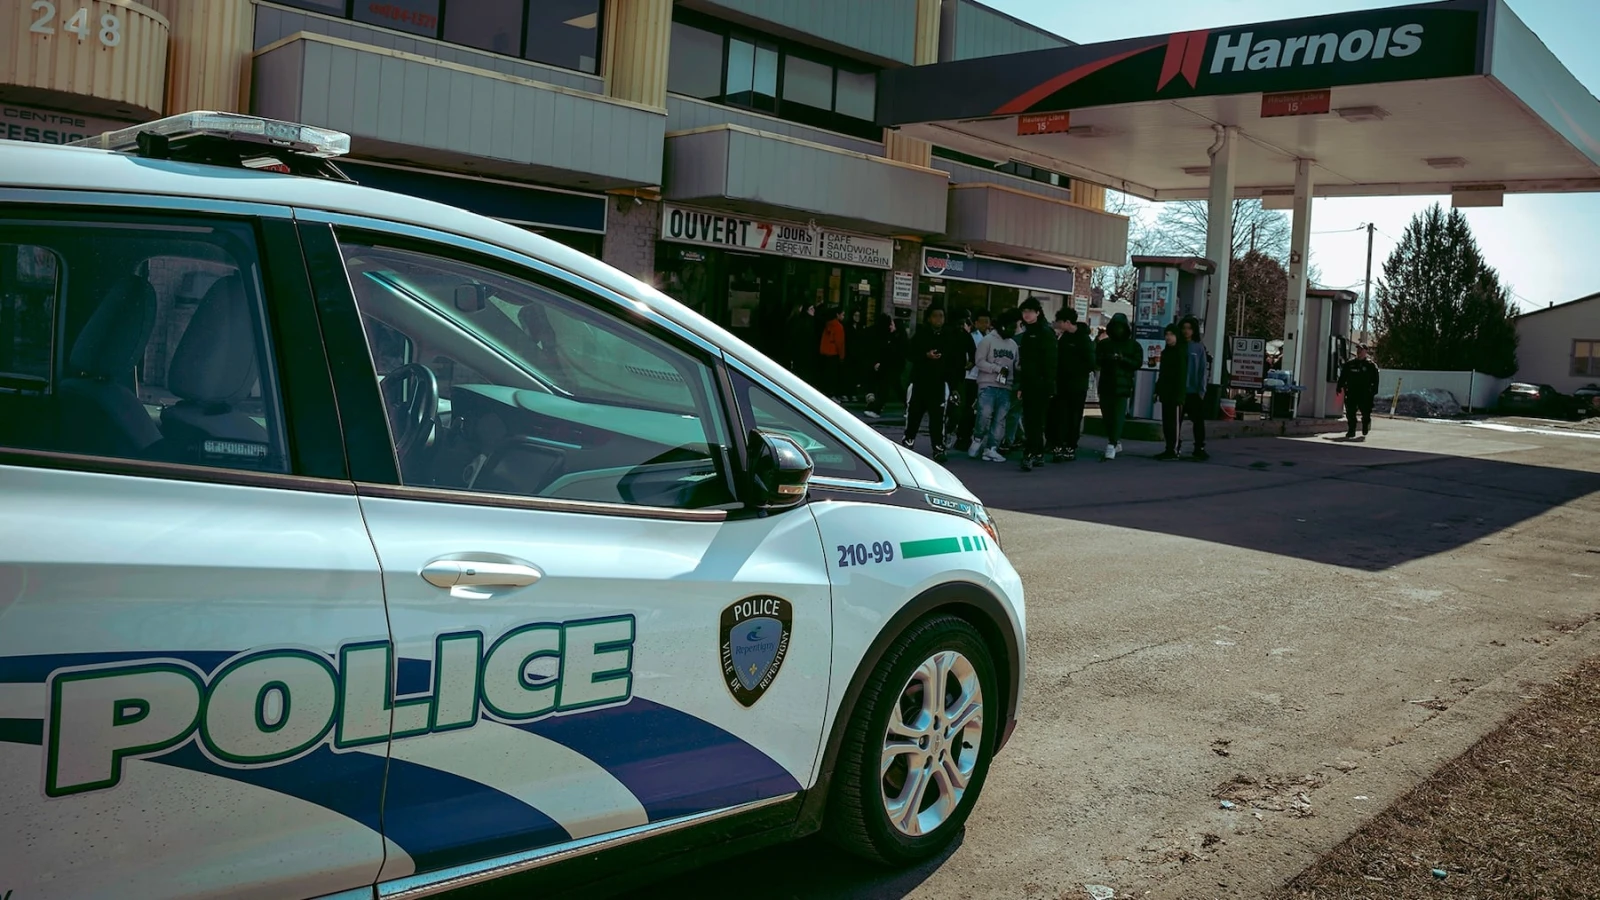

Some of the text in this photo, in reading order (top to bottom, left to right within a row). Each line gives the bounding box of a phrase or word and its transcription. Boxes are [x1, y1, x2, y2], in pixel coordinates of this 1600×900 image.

[29, 0, 121, 47] 248
[1209, 23, 1425, 74] Harnois
[3, 107, 86, 128] CENTRE
[670, 209, 813, 250] OUVERT 7 JOURS
[826, 242, 879, 256] SANDWICH
[826, 250, 890, 266] SOUS-MARIN
[932, 497, 958, 508] BOLT
[836, 540, 894, 568] 210-99
[733, 598, 781, 621] POLICE
[735, 641, 775, 656] Repentigny
[722, 641, 734, 675] VILLE
[730, 677, 742, 693] DE
[759, 630, 790, 690] REPENTIGNY
[44, 612, 636, 799] POLICE
